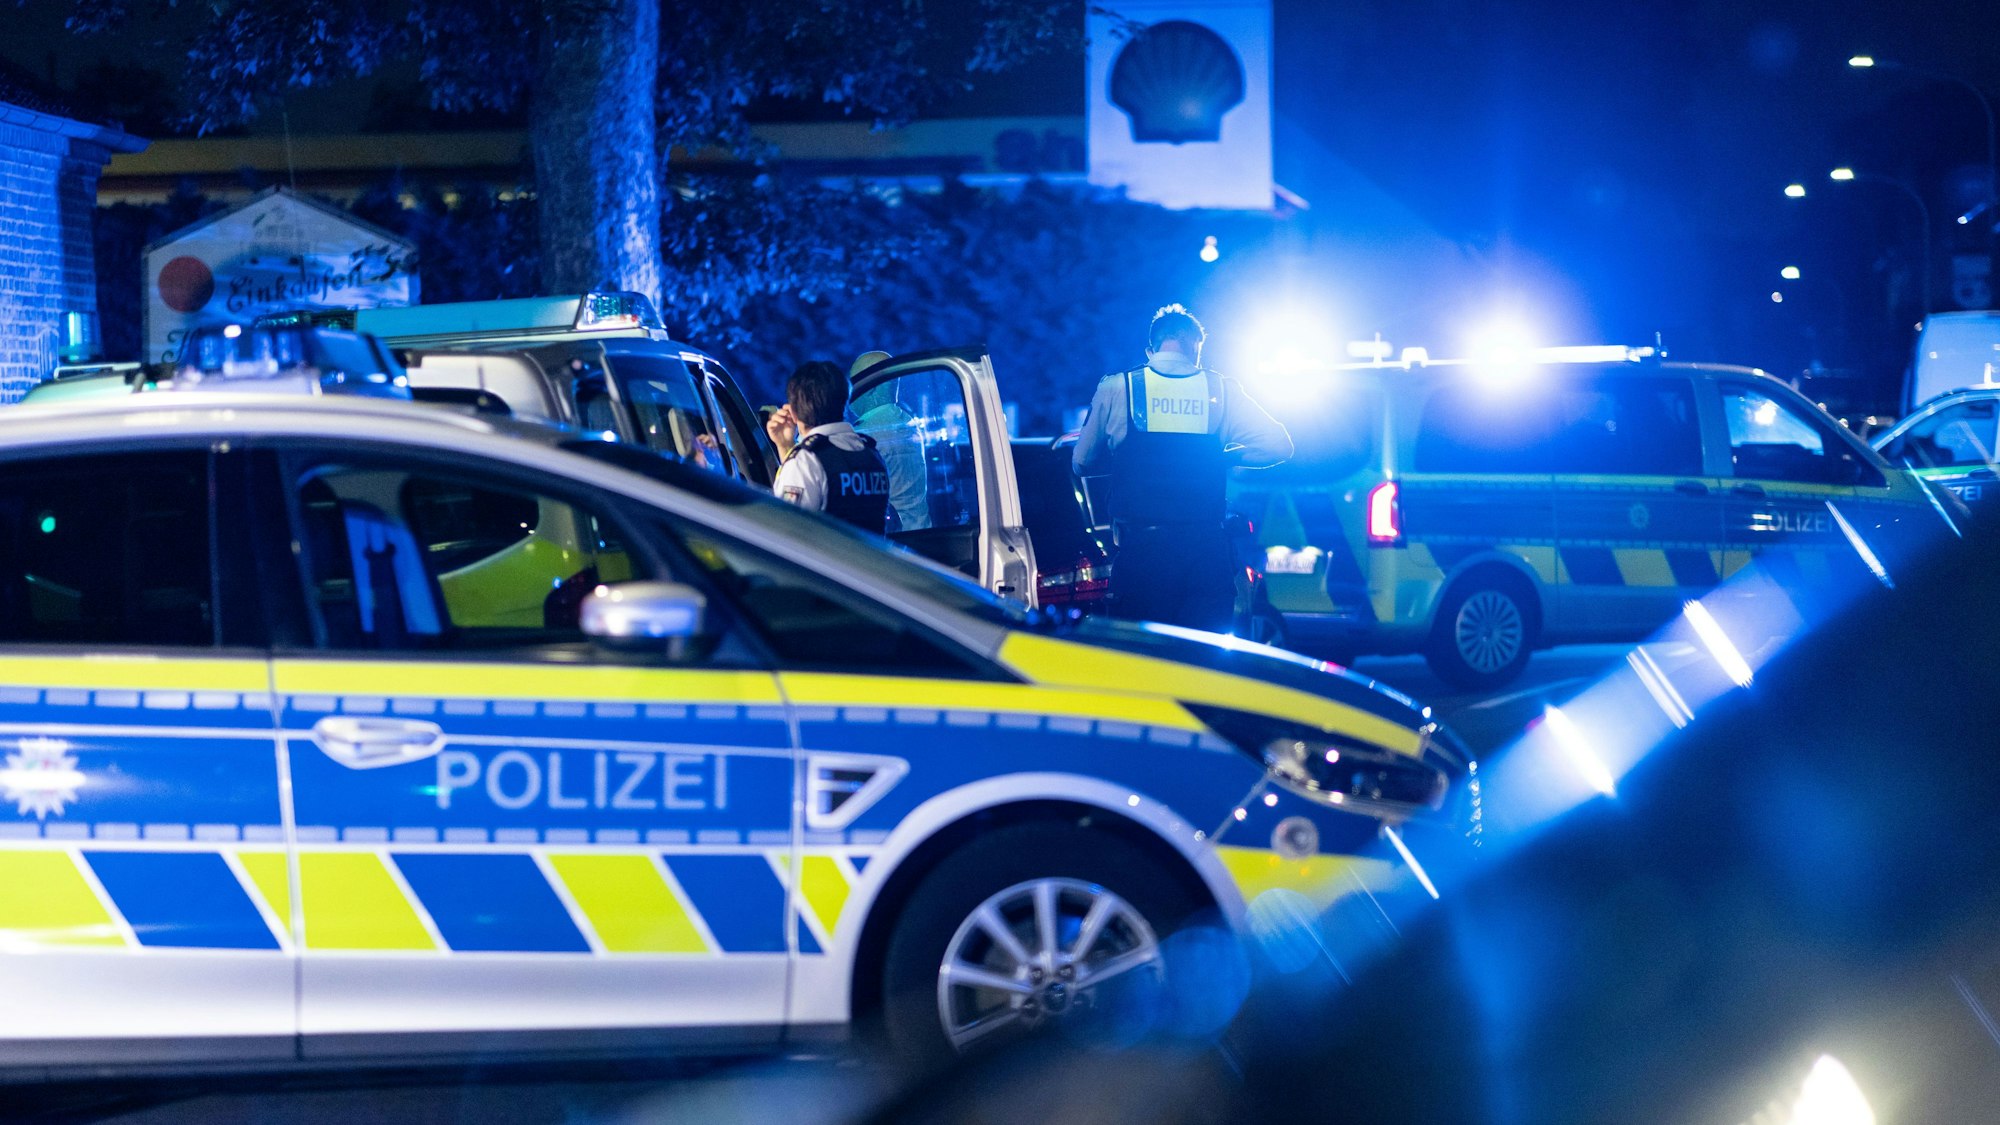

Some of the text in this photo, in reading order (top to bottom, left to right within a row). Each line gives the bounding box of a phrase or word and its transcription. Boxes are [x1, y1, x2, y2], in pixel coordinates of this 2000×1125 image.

[1151, 397, 1204, 416] POLIZEI
[840, 471, 889, 497] POLIZE
[436, 750, 728, 810] POLIZEI
